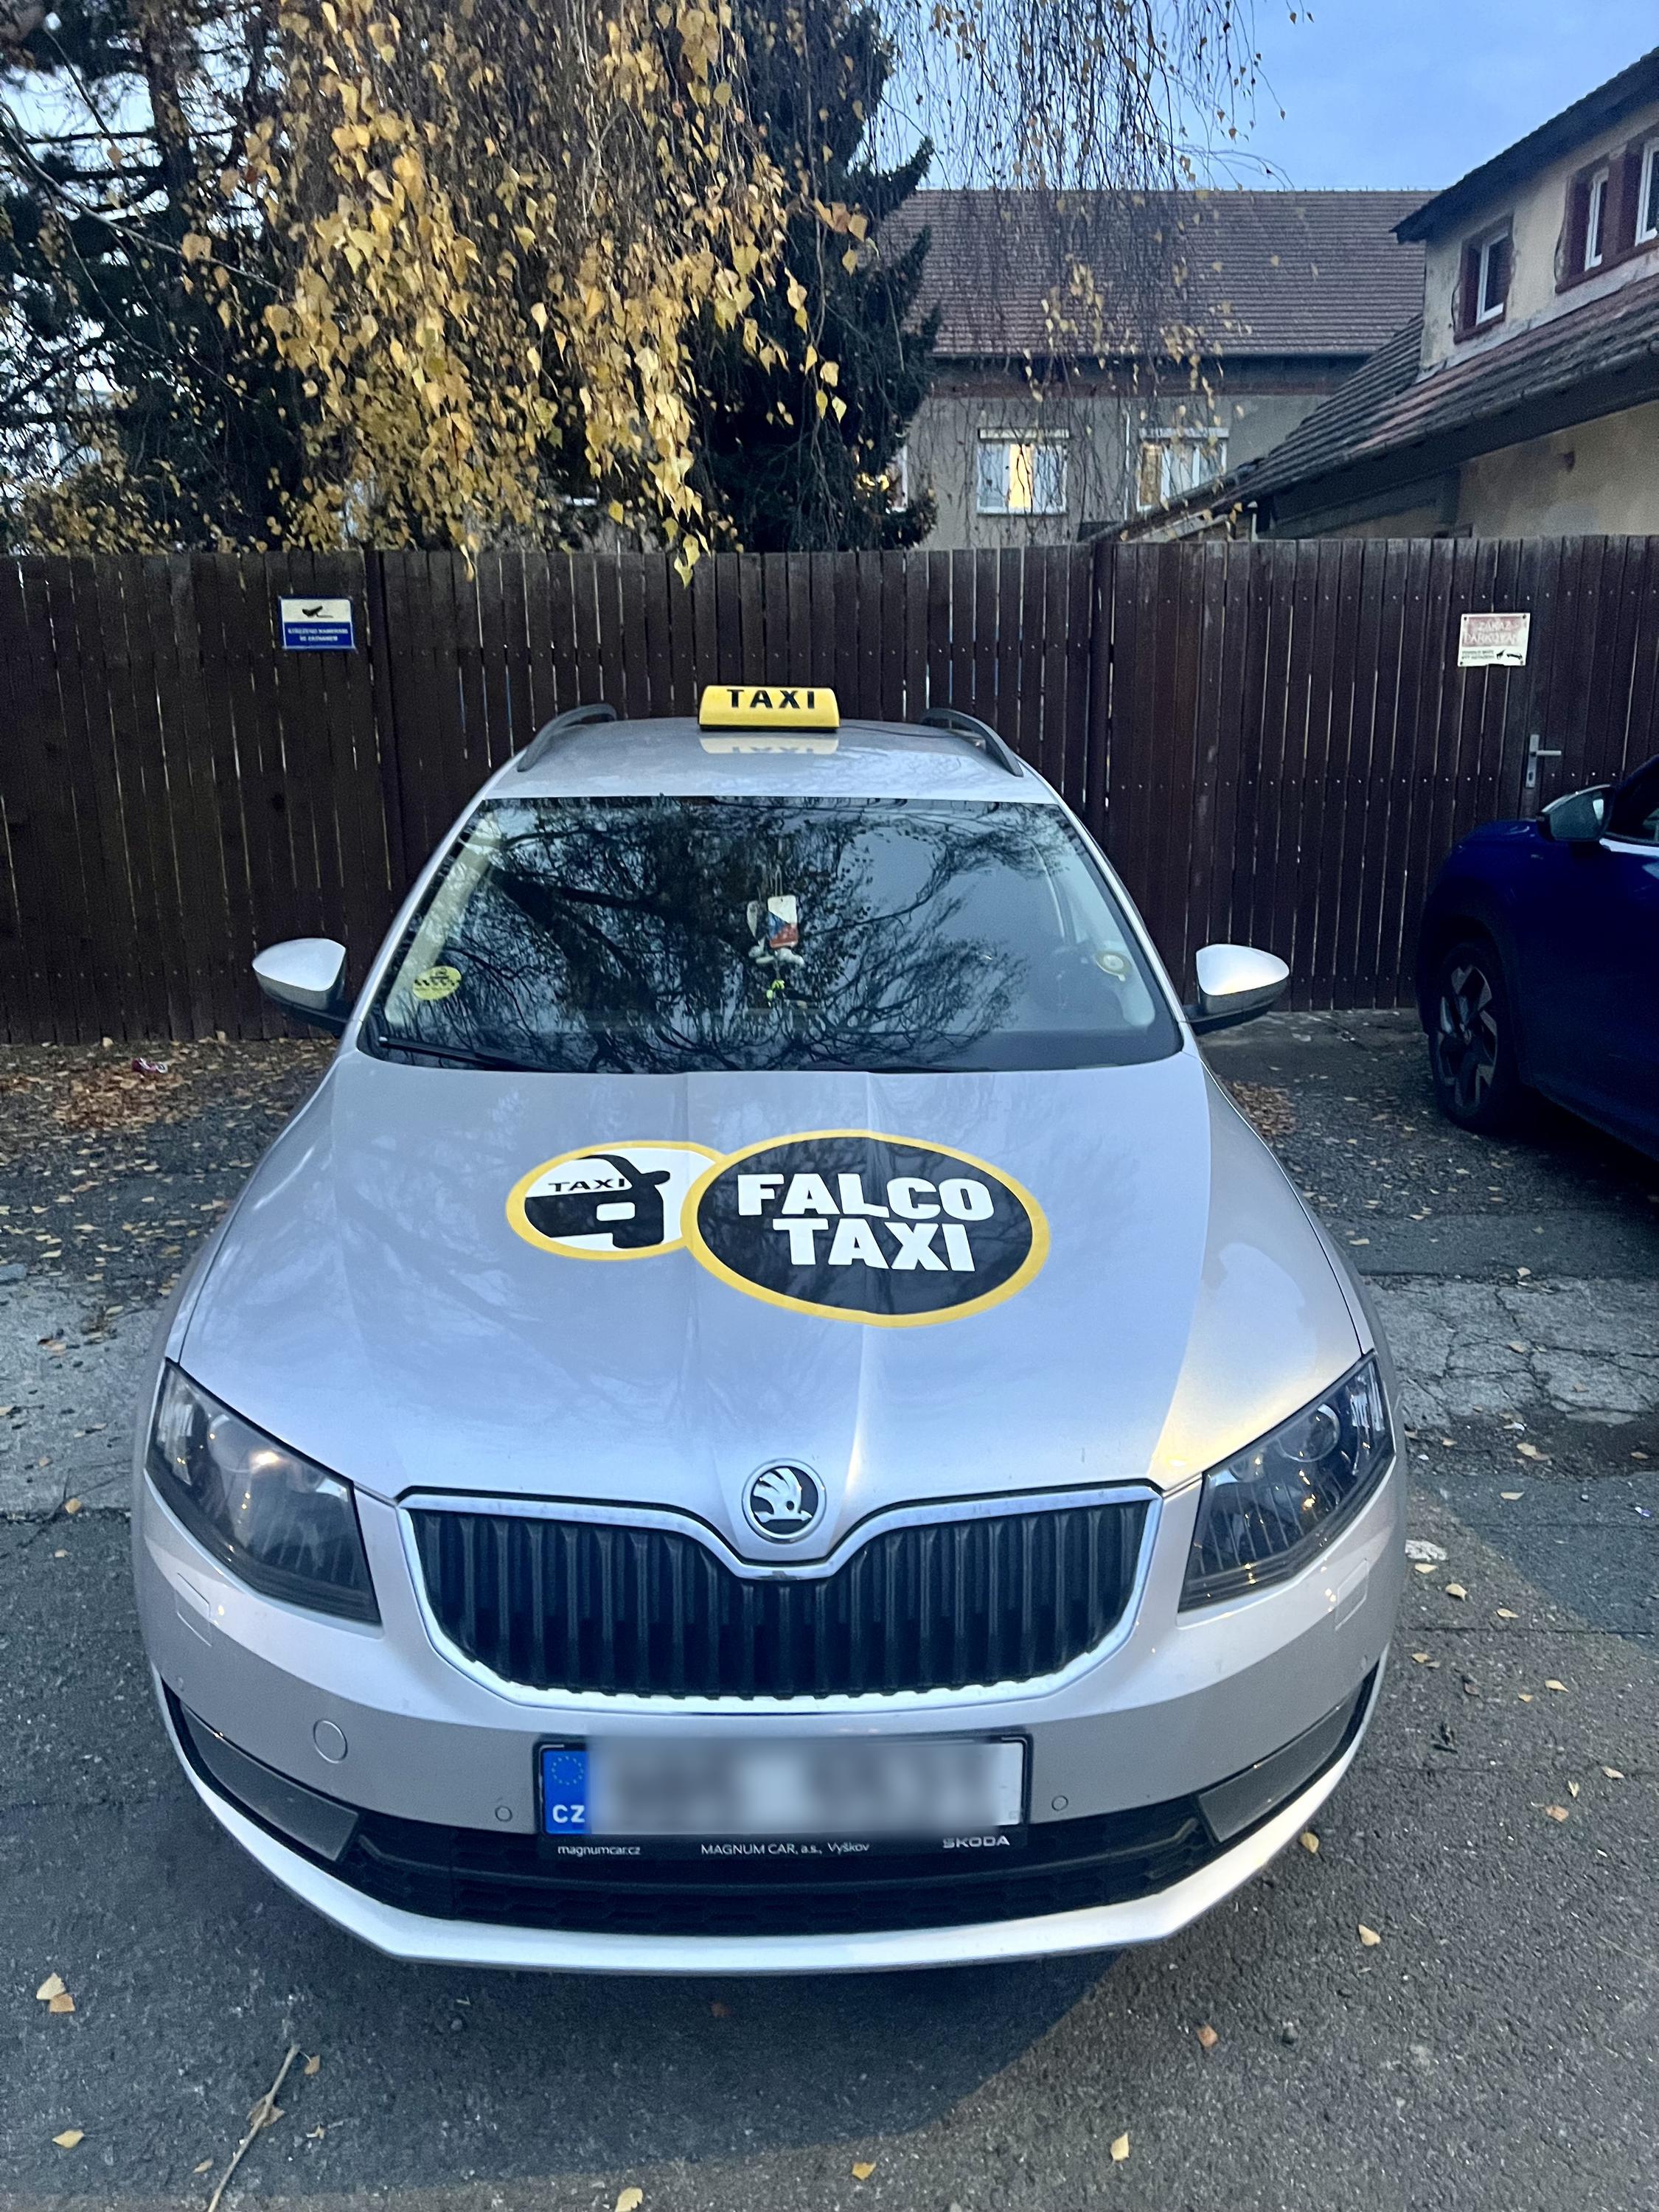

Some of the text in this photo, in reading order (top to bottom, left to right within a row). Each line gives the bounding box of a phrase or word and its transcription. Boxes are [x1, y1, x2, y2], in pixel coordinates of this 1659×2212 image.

[727, 689, 815, 709] TAXI
[549, 1178, 625, 1192] TAXI
[737, 1173, 995, 1221] FALCO
[773, 1218, 975, 1272] TAXI
[553, 1804, 585, 1823] CZ
[701, 1844, 765, 1854] MAGNUM
